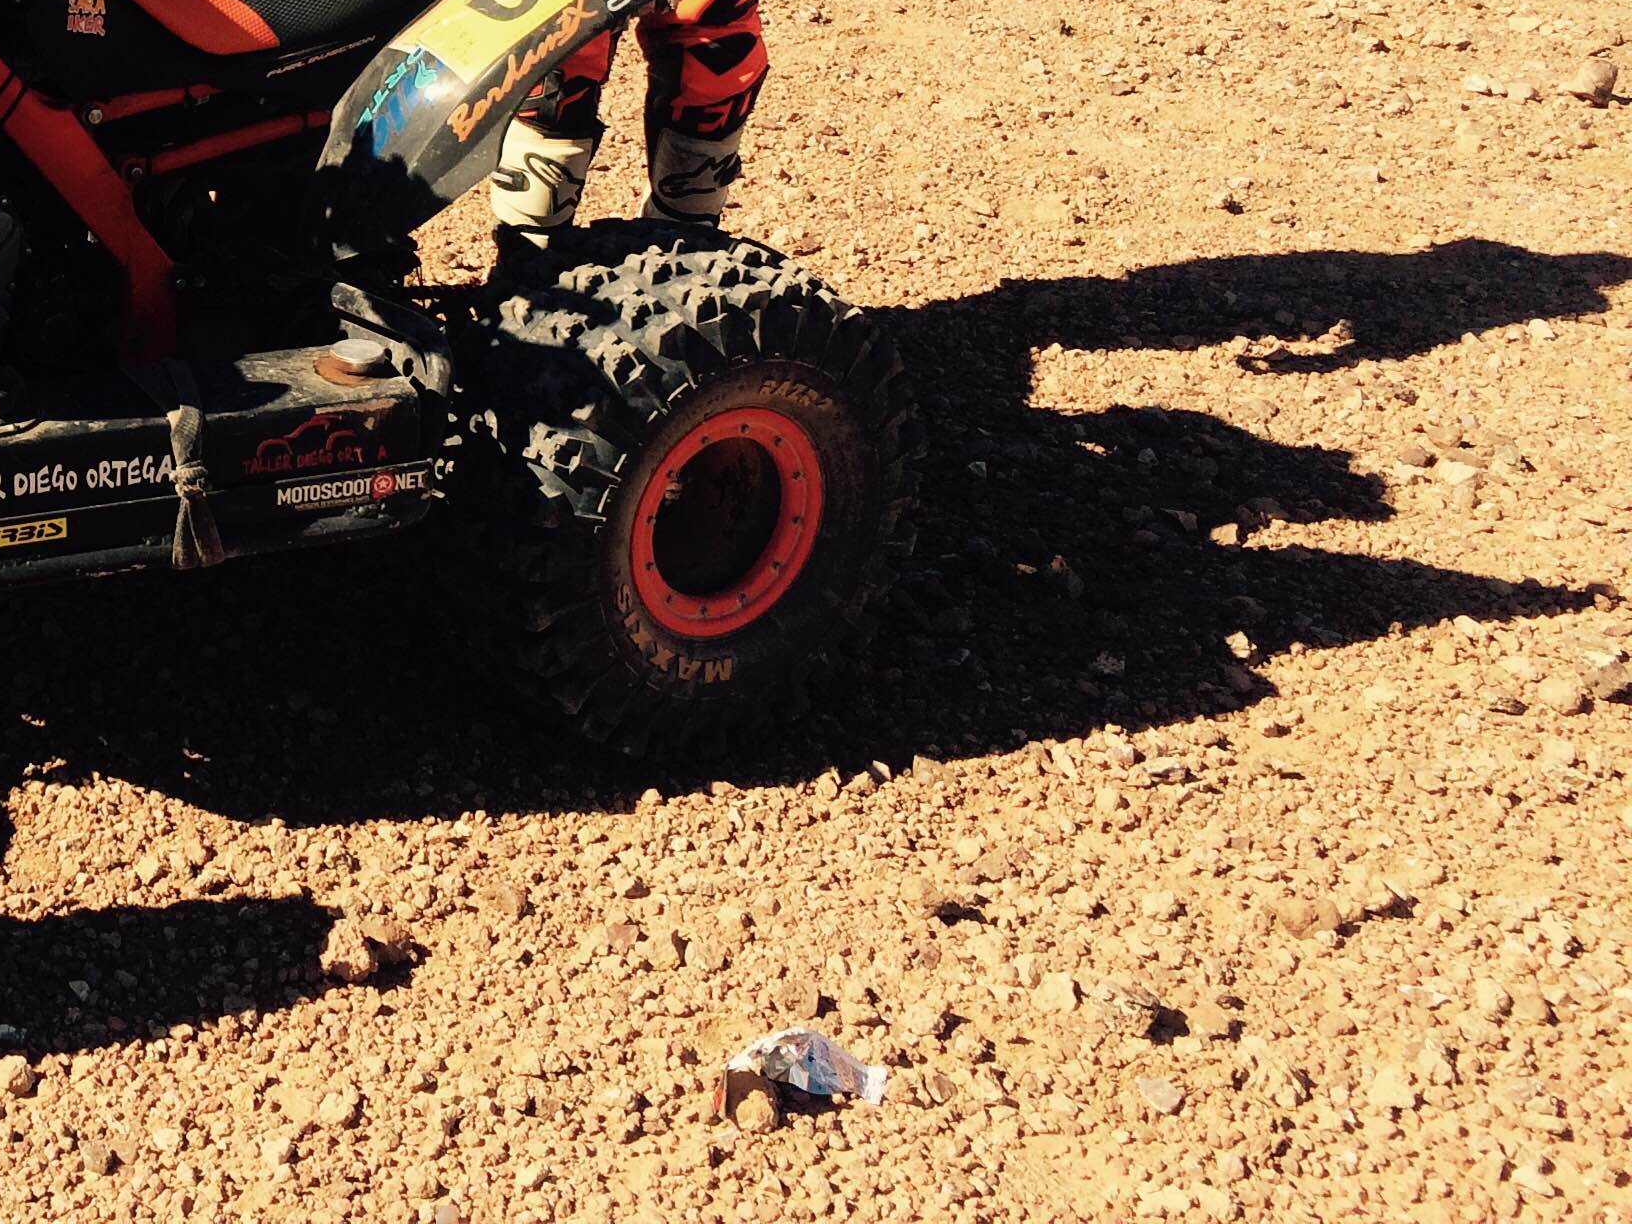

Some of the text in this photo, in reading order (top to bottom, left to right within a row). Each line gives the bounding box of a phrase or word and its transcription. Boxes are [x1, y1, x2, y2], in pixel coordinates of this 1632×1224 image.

[13, 463, 79, 496] DIEGO
[86, 453, 176, 488] ORTEGA
[276, 477, 372, 507] MOTOSCOOT
[395, 470, 426, 491] NET
[615, 582, 733, 683] MAXXIS
